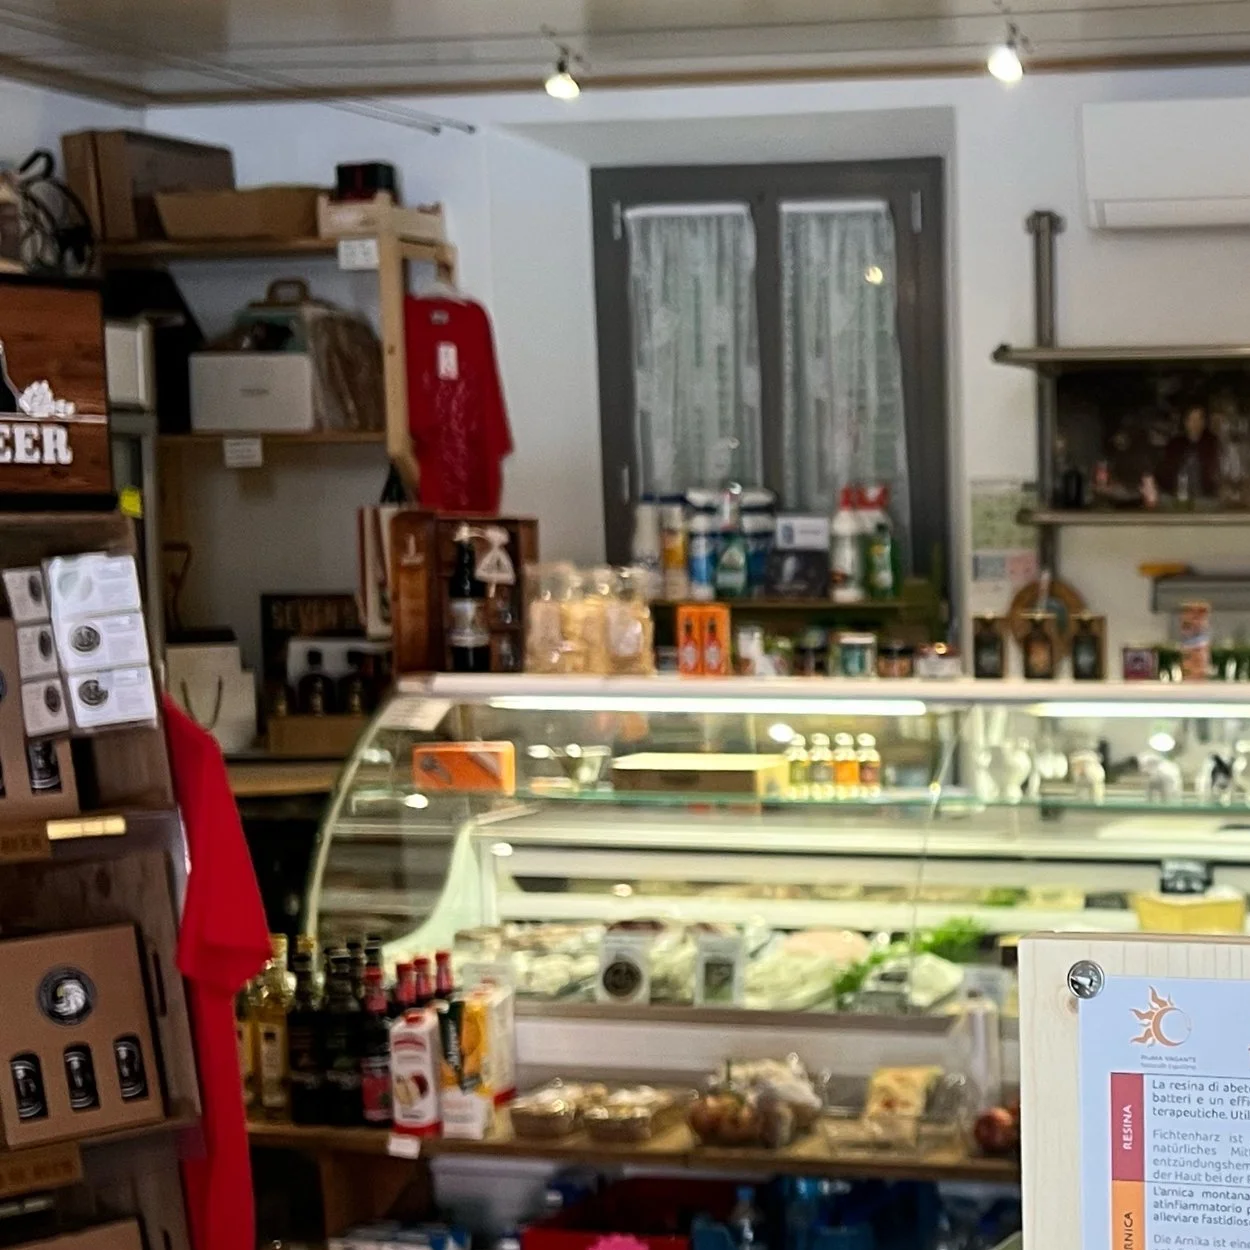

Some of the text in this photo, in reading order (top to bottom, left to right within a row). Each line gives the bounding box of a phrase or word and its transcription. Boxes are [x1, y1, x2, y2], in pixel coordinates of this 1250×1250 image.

[1152, 1079, 1165, 1089] La
[1169, 1081, 1204, 1091] resina
[1207, 1082, 1219, 1092] di
[1152, 1093, 1191, 1104] batteri
[1209, 1097, 1224, 1105] un
[1123, 1104, 1133, 1151] RESINA
